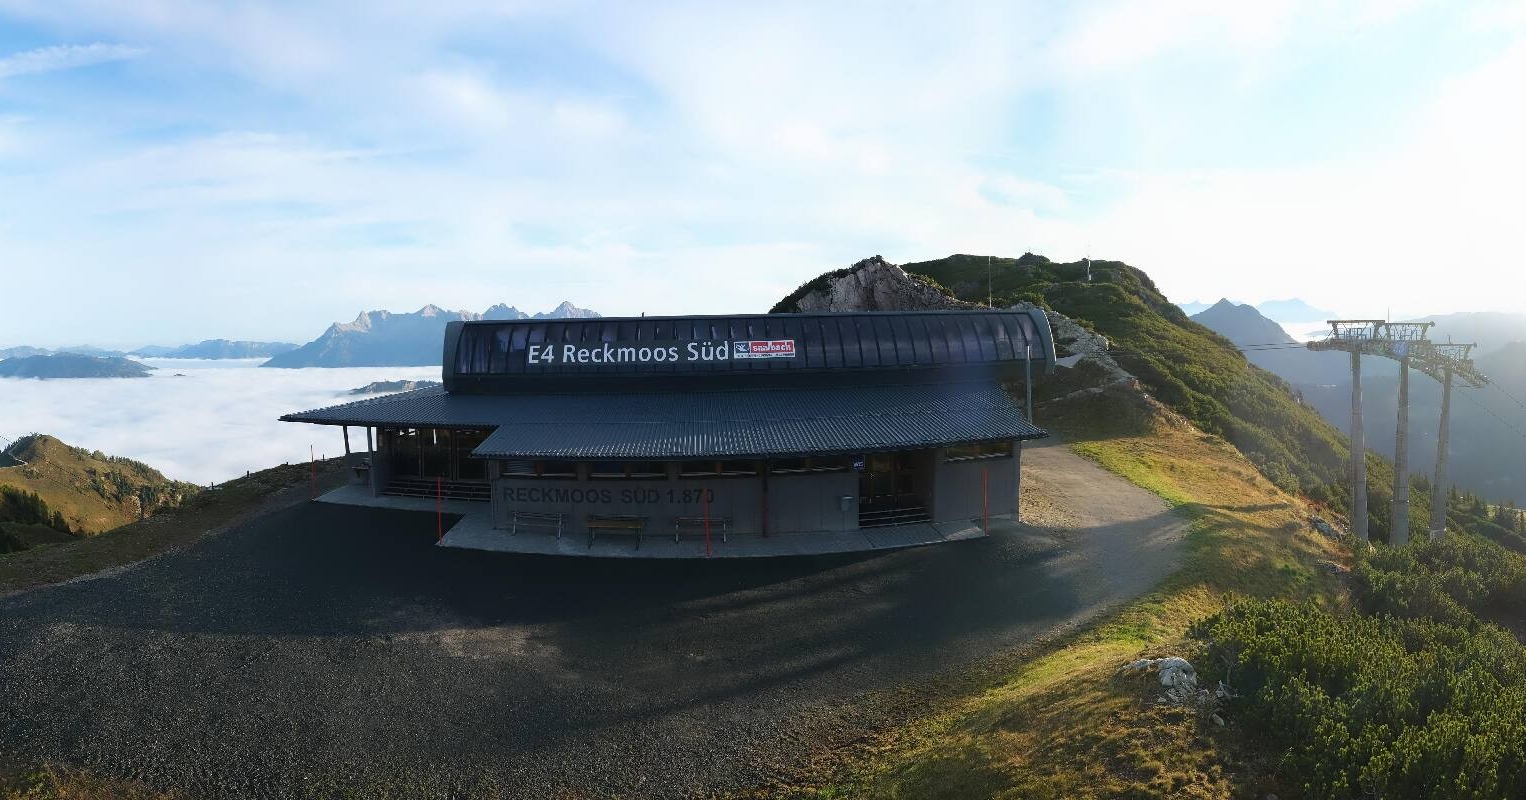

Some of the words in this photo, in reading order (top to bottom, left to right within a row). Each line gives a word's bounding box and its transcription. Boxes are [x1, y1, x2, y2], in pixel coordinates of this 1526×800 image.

[528, 345, 555, 364] E4
[562, 343, 679, 363] Reckmoos
[687, 341, 728, 361] Süd
[503, 487, 612, 504] RECKMOOS
